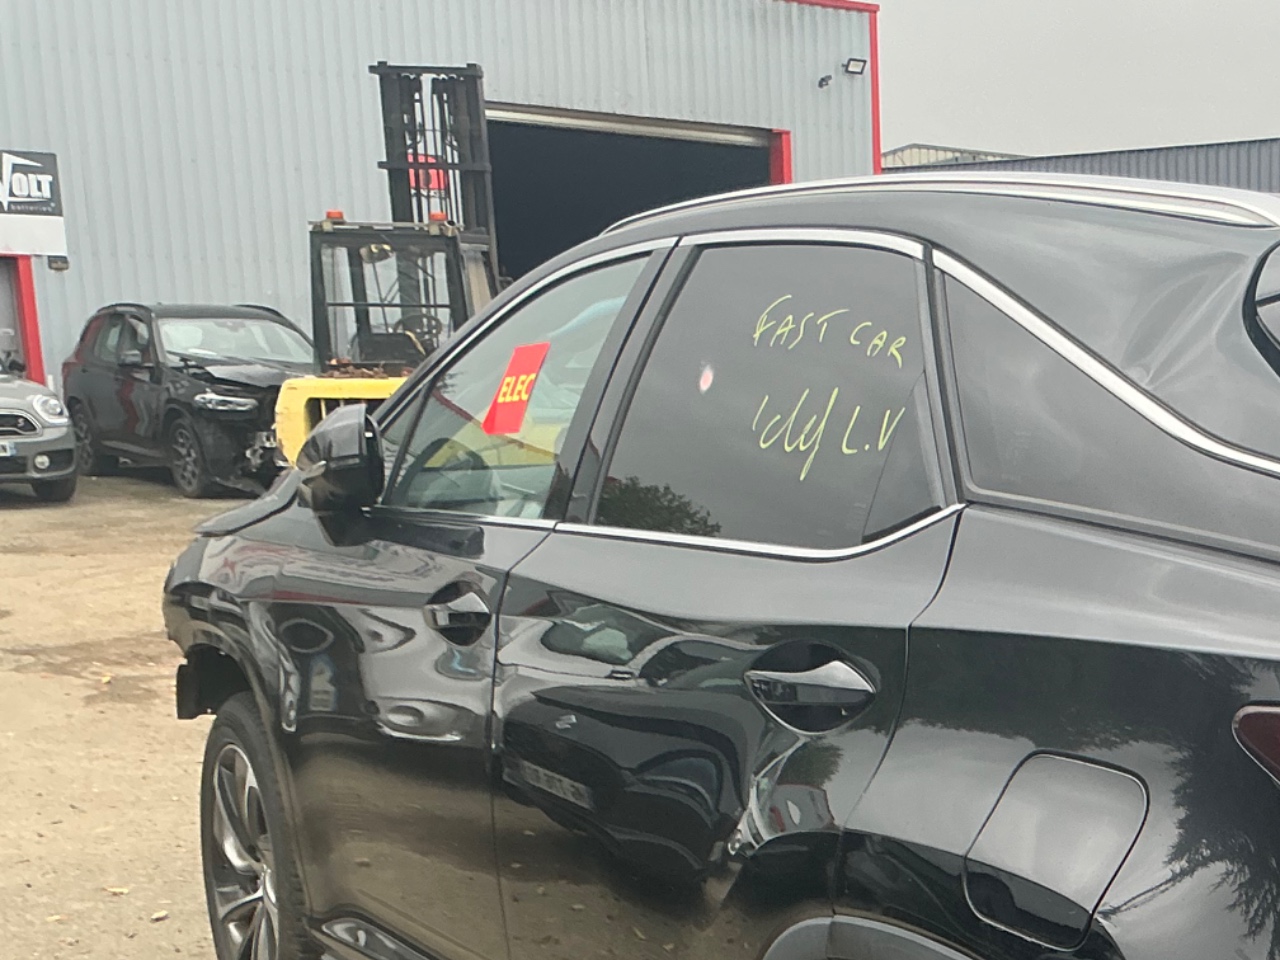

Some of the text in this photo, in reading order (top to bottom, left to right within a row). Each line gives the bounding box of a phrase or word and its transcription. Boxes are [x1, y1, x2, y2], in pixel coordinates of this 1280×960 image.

[753, 294, 907, 369] FAST CAR
[497, 372, 537, 403] ELEC
